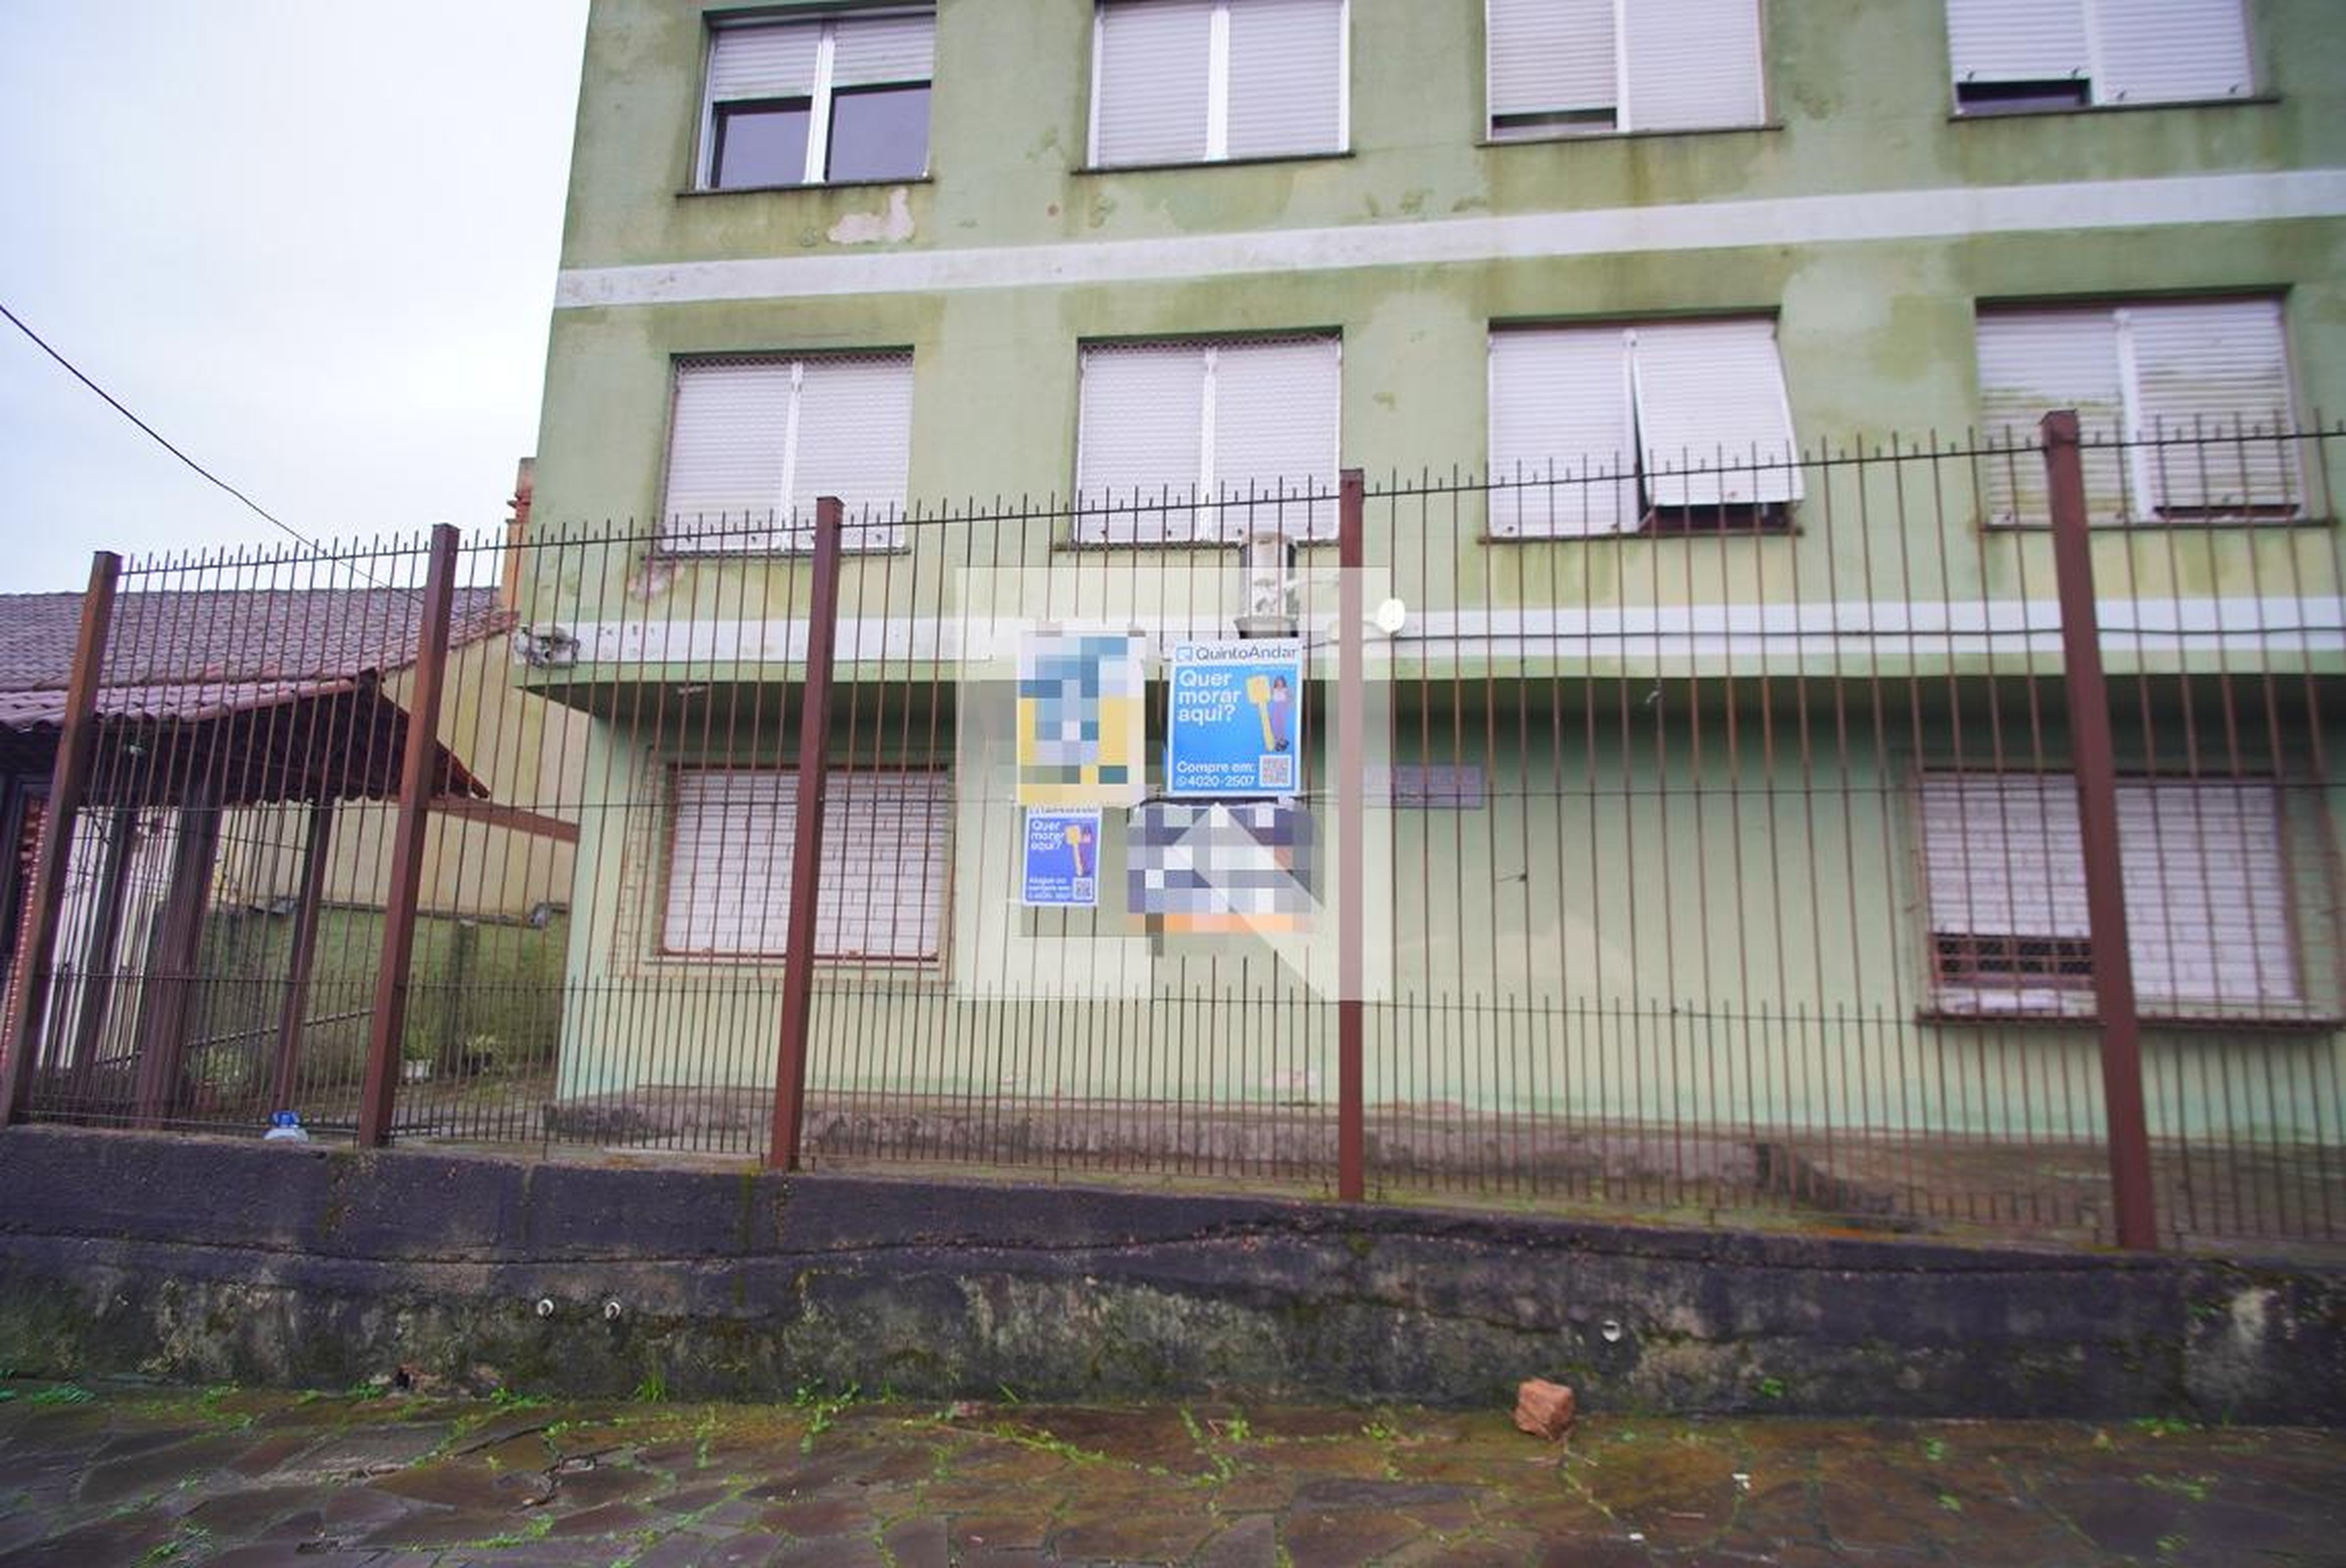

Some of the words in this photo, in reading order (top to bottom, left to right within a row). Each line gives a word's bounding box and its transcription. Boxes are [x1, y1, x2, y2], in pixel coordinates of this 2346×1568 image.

[1196, 646, 1298, 660] QuintoAndar
[1179, 669, 1232, 687] Quer
[1179, 691, 1241, 704] morar
[1178, 704, 1235, 726] aqui?
[1176, 761, 1228, 774] Compre
